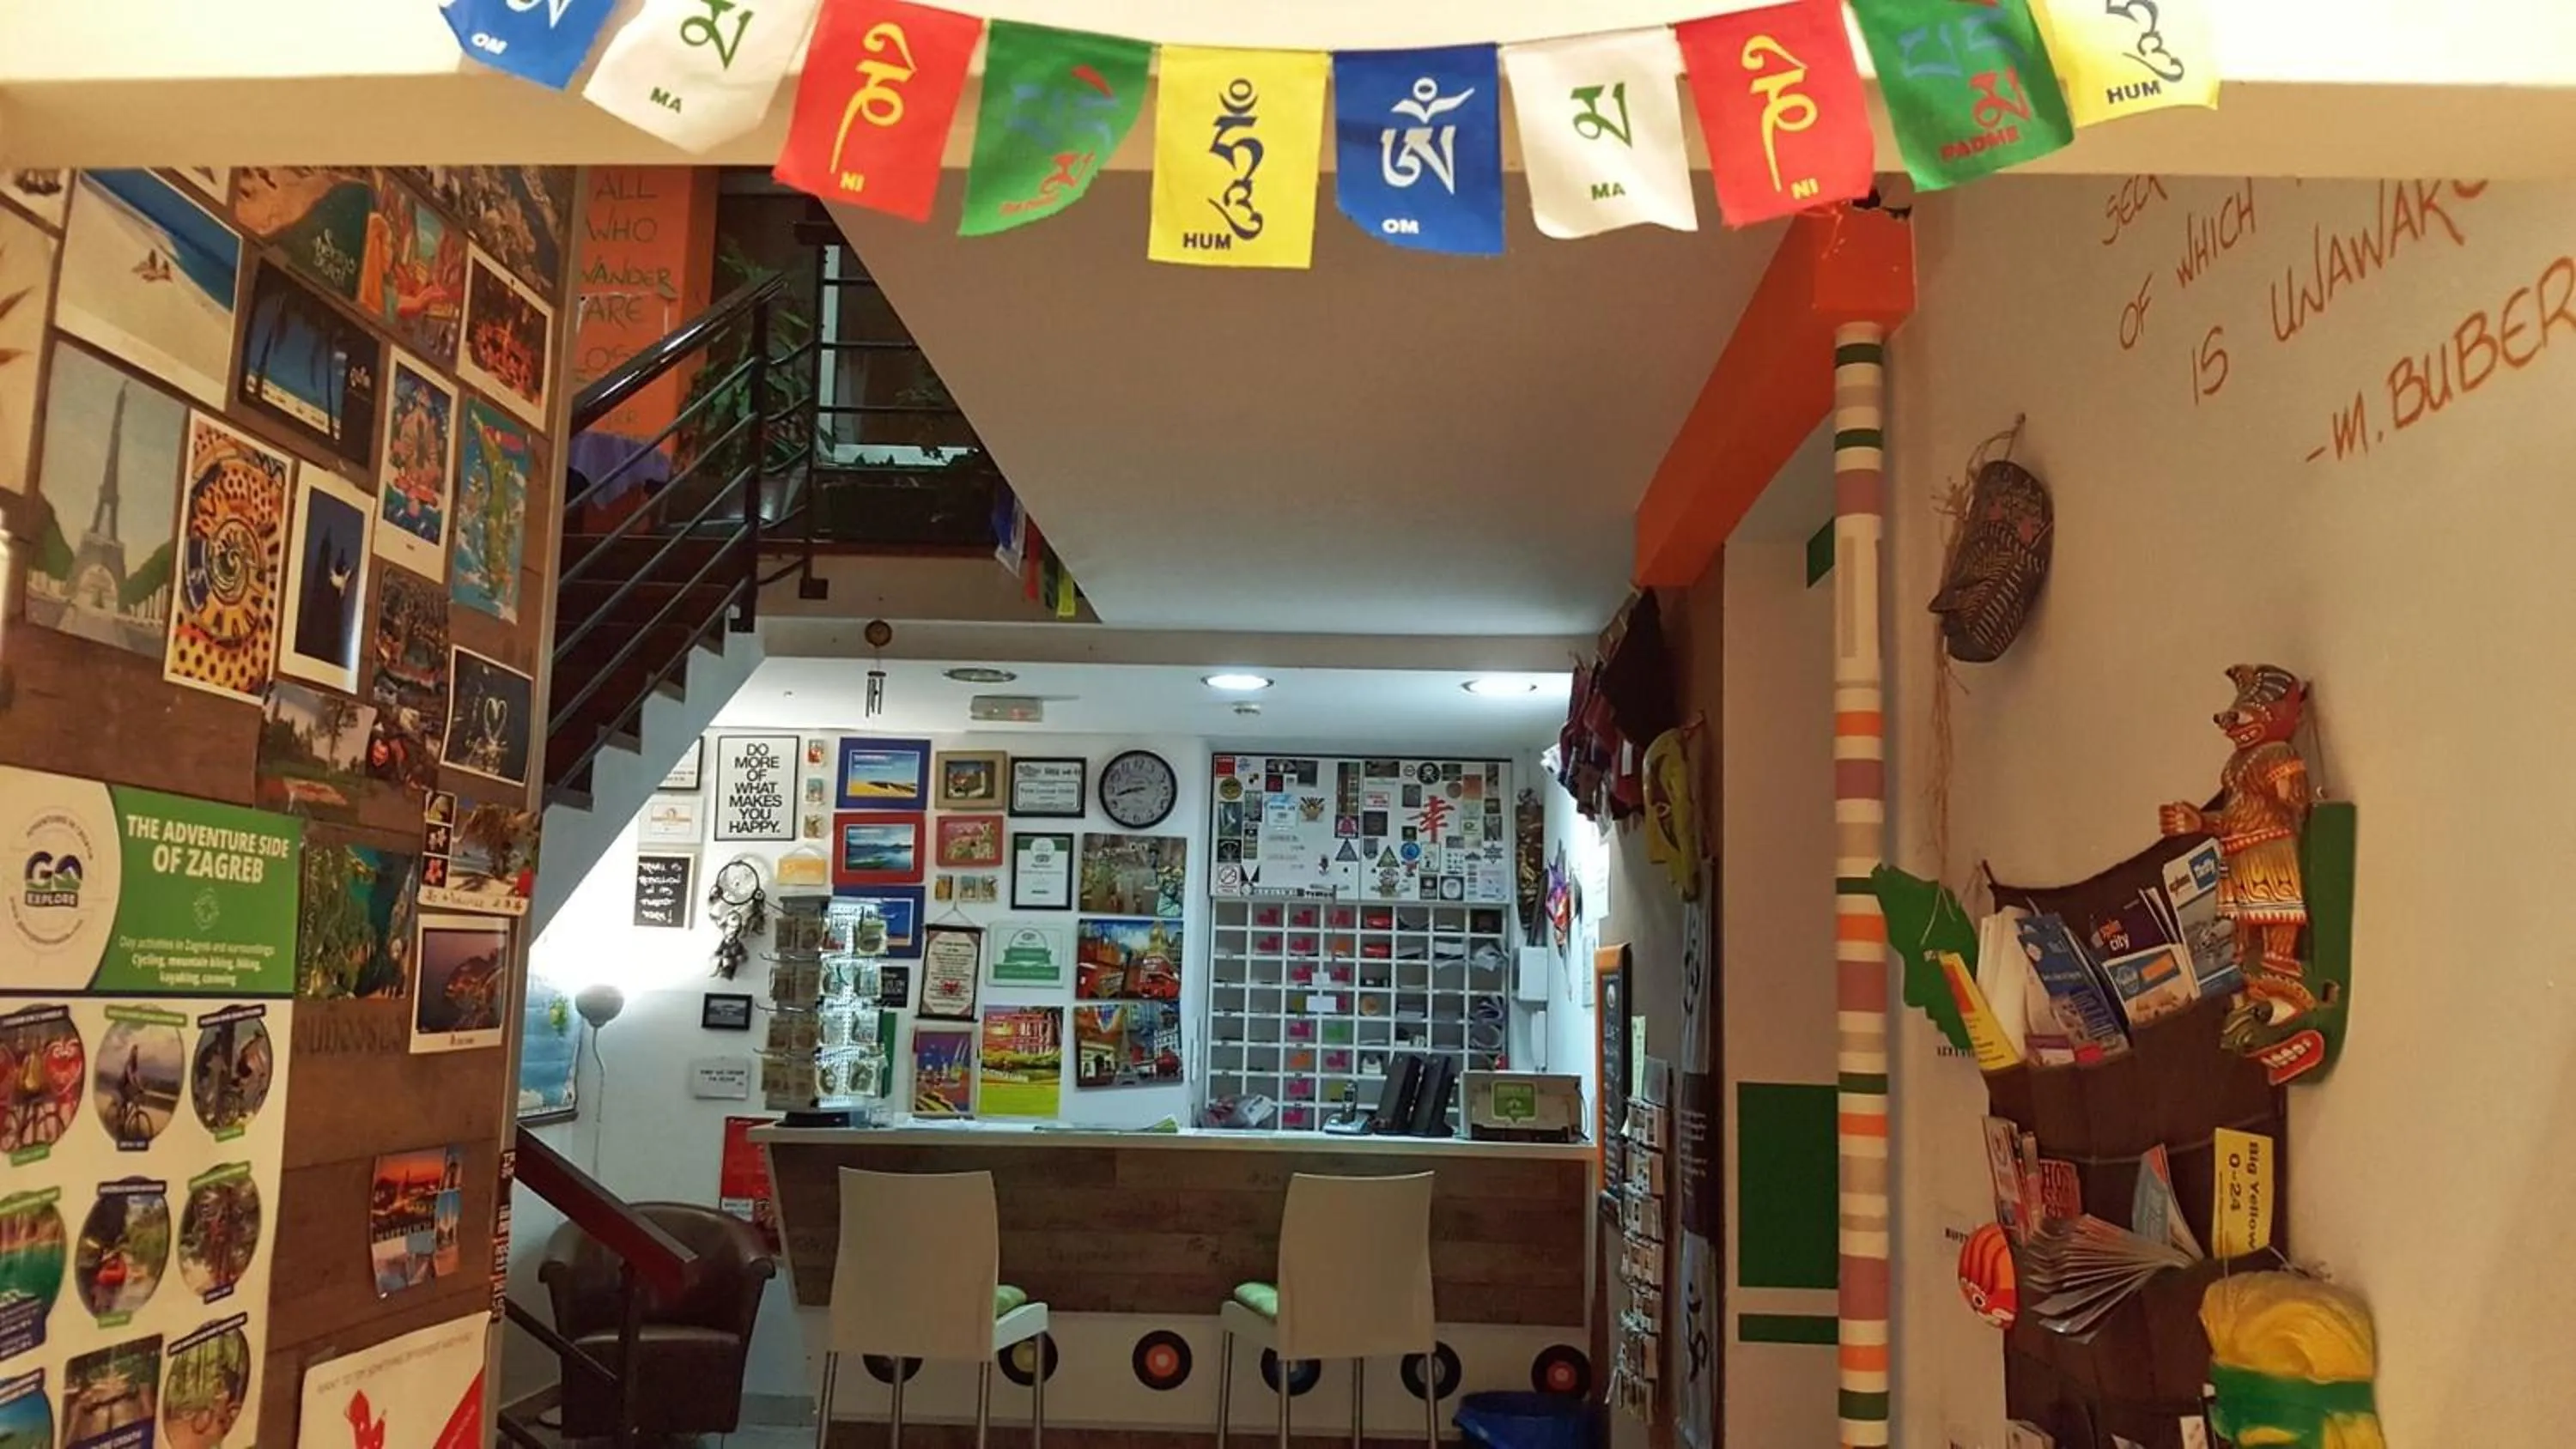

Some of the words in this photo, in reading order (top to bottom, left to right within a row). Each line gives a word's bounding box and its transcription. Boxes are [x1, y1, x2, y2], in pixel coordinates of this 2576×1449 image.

[471, 32, 508, 56] OM
[649, 87, 683, 114] MA
[2105, 81, 2161, 105] HUM
[1940, 124, 2020, 163] PADME
[595, 173, 659, 200] ALL
[840, 171, 864, 192] NI
[1590, 183, 1626, 200] MA
[1790, 179, 1819, 200] NI
[584, 208, 658, 243] WHO
[1382, 218, 1419, 235] OM
[1182, 231, 1232, 251] HUM
[2119, 273, 2154, 350] OF
[2176, 176, 2257, 289] WHICH
[583, 295, 644, 330] ARE
[2387, 256, 2576, 431] BUBER
[2192, 326, 2228, 406] IS
[746, 743, 769, 756] DO
[734, 756, 780, 769] MORE
[746, 769, 768, 782] OF
[734, 782, 778, 795] WHAT
[729, 795, 782, 808] MAKES
[739, 808, 772, 820] YOU
[126, 815, 161, 840] THE
[162, 820, 258, 854] ADVENTURE
[258, 834, 290, 858] SIDE
[729, 821, 781, 834] HAPPY.
[25, 851, 83, 890] GO
[152, 843, 183, 874] OF
[185, 847, 264, 884] ZAGREB
[27, 892, 76, 906] EXPLORE
[2109, 932, 2130, 952] city
[2246, 1141, 2259, 1175] Big
[2228, 1153, 2242, 1210] 0-24
[2247, 1180, 2260, 1251] Yellow
